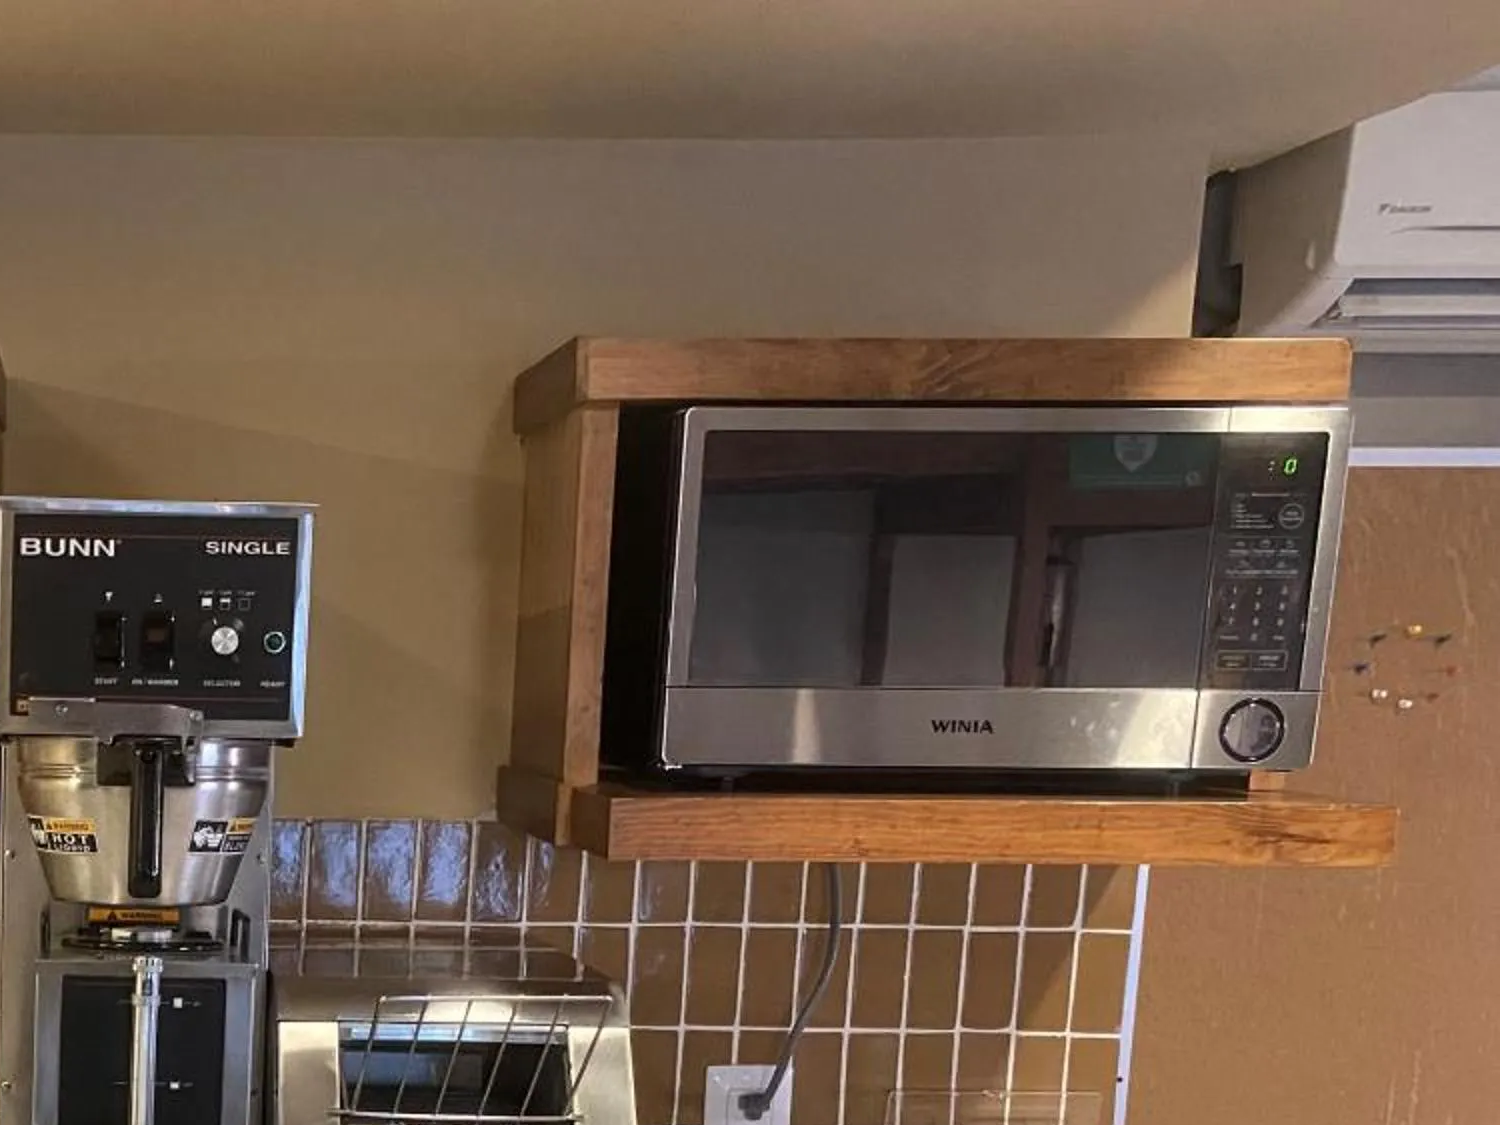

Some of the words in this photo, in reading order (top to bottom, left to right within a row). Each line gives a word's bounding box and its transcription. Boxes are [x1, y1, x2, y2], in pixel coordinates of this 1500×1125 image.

[19, 537, 116, 557] BUNN
[205, 541, 291, 555] SINGLE
[931, 719, 995, 734] WINIA
